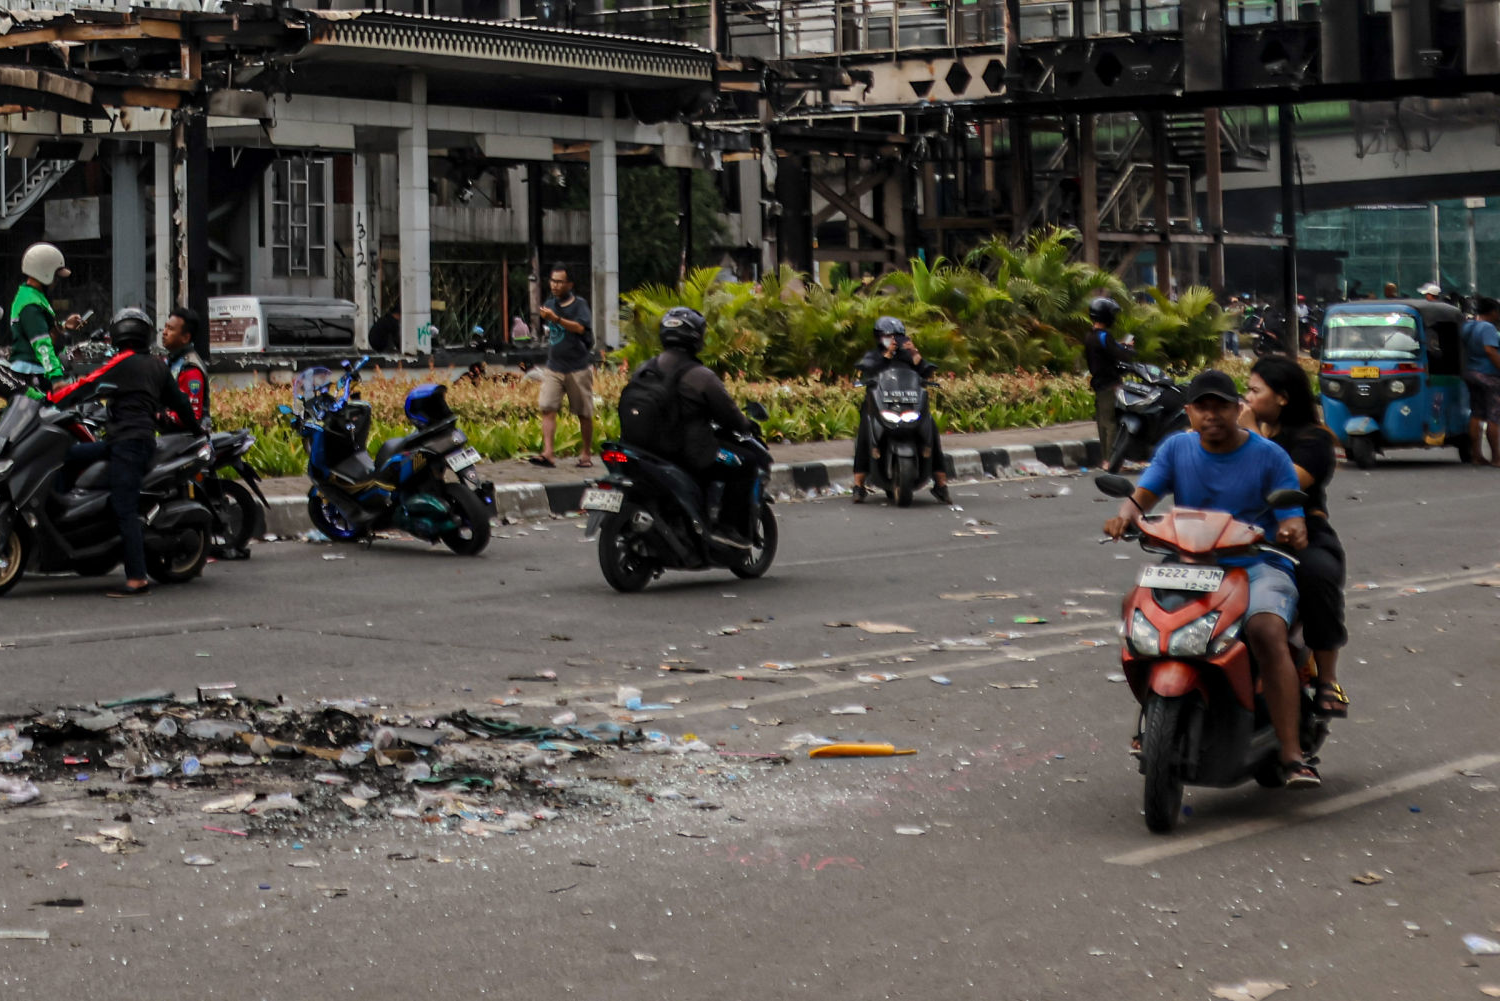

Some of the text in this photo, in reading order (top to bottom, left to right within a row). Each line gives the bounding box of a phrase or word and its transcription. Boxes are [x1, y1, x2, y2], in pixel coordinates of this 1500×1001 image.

[357, 211, 367, 268] 1312
[1145, 567, 1154, 577] B
[1157, 568, 1189, 578] 6222
